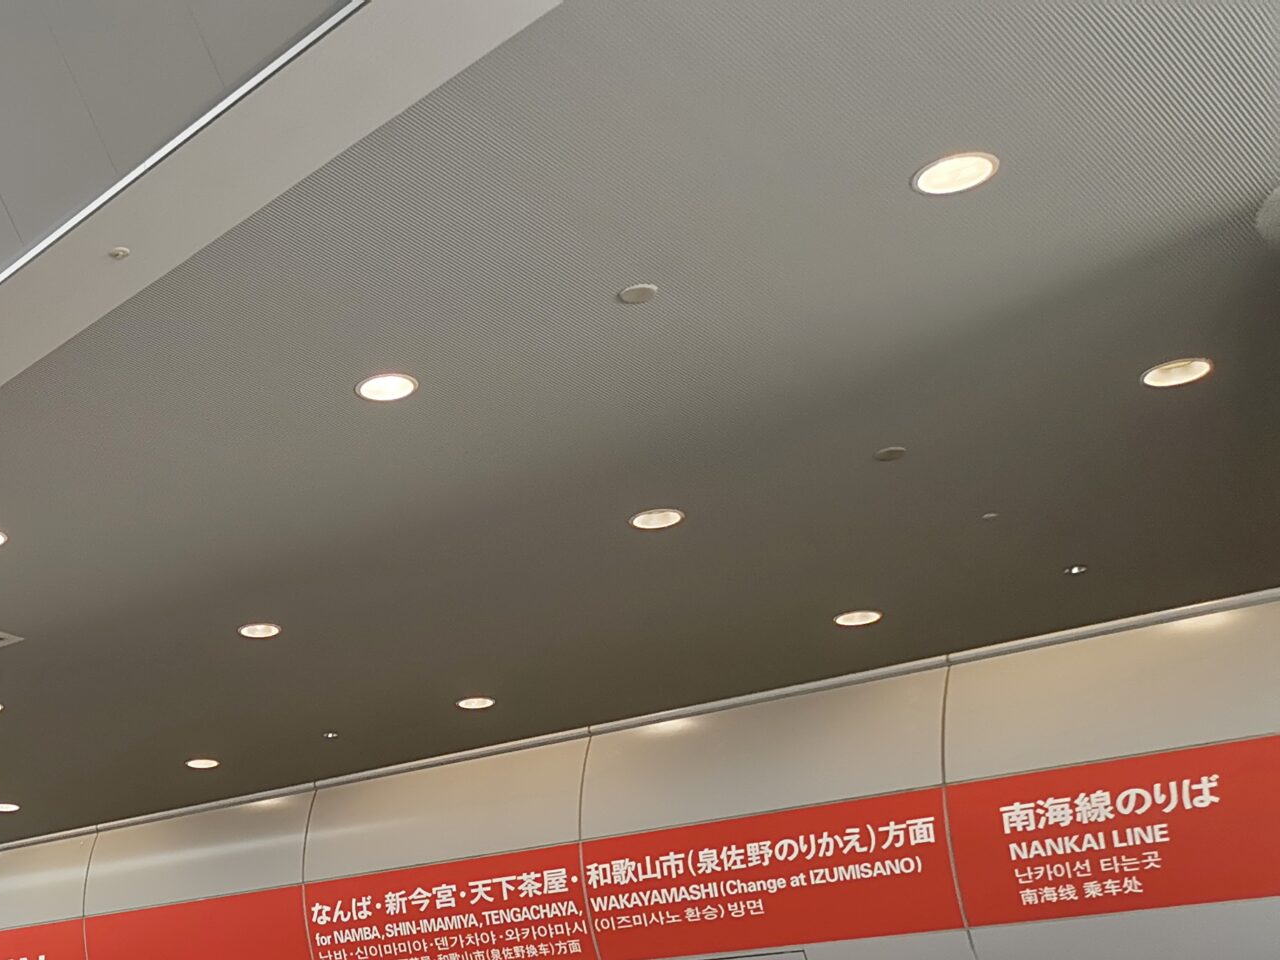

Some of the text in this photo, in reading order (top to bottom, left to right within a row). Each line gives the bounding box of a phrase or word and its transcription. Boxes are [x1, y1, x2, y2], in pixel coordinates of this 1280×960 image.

[999, 774, 1221, 834] 南海線のりば
[1009, 823, 1170, 861] NANKAI LINE
[1014, 851, 1162, 884] 난카이선 타는곳
[315, 855, 923, 947] for NAMBA, SHIN-IMAMIYA, TENGACHAYA, WAKAYAMASHI (Change at IZUMISANO)
[727, 898, 765, 917] 방면
[1019, 884, 1078, 906] 南海线
